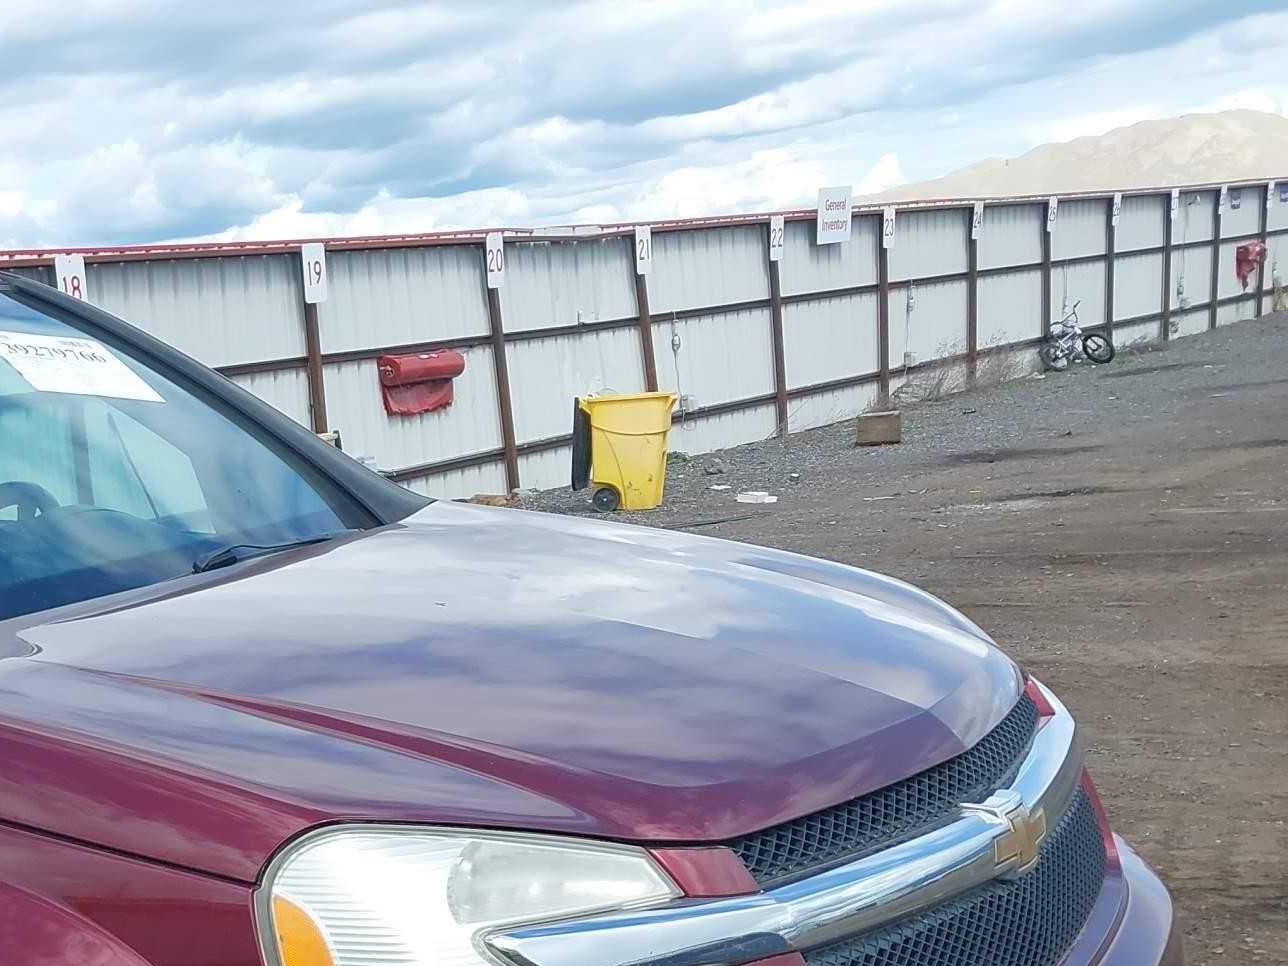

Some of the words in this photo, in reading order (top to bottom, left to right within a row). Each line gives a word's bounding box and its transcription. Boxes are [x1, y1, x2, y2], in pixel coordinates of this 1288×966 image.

[825, 198, 846, 211] General
[822, 219, 847, 232] Inventory
[885, 218, 894, 237] 23
[772, 227, 782, 247] 22
[639, 238, 649, 260] 21
[488, 248, 502, 272] 20
[307, 260, 322, 286] 19
[62, 275, 82, 300] 18
[0, 342, 107, 363] 39279766
